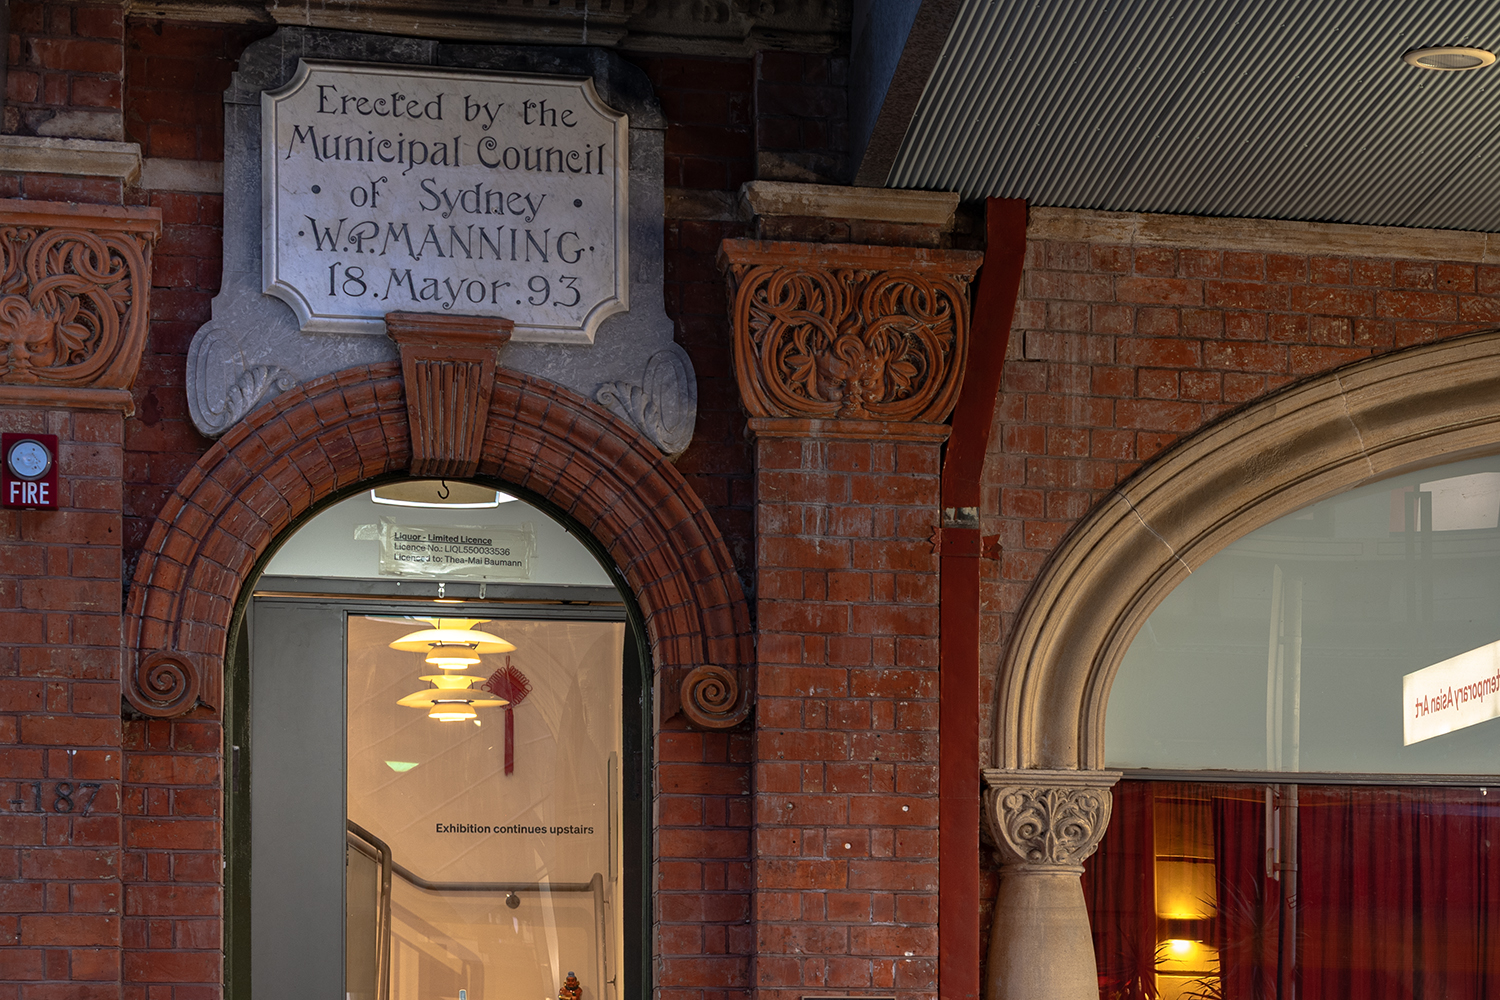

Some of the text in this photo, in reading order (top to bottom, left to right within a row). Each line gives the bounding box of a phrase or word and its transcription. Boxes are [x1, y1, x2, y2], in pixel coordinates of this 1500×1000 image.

[316, 84, 578, 131] Erected by the
[285, 124, 606, 176] Municipal Council
[350, 176, 547, 223] of Sydney
[10, 481, 49, 504] FIRE
[394, 532, 421, 541] Liquor
[428, 534, 459, 543] Limited
[460, 536, 493, 545] Licence
[394, 543, 426, 551] Licence
[444, 555, 483, 565] Thea-Mai
[484, 558, 522, 567] Baumann
[436, 823, 594, 836] Exhibition continues upstairs
